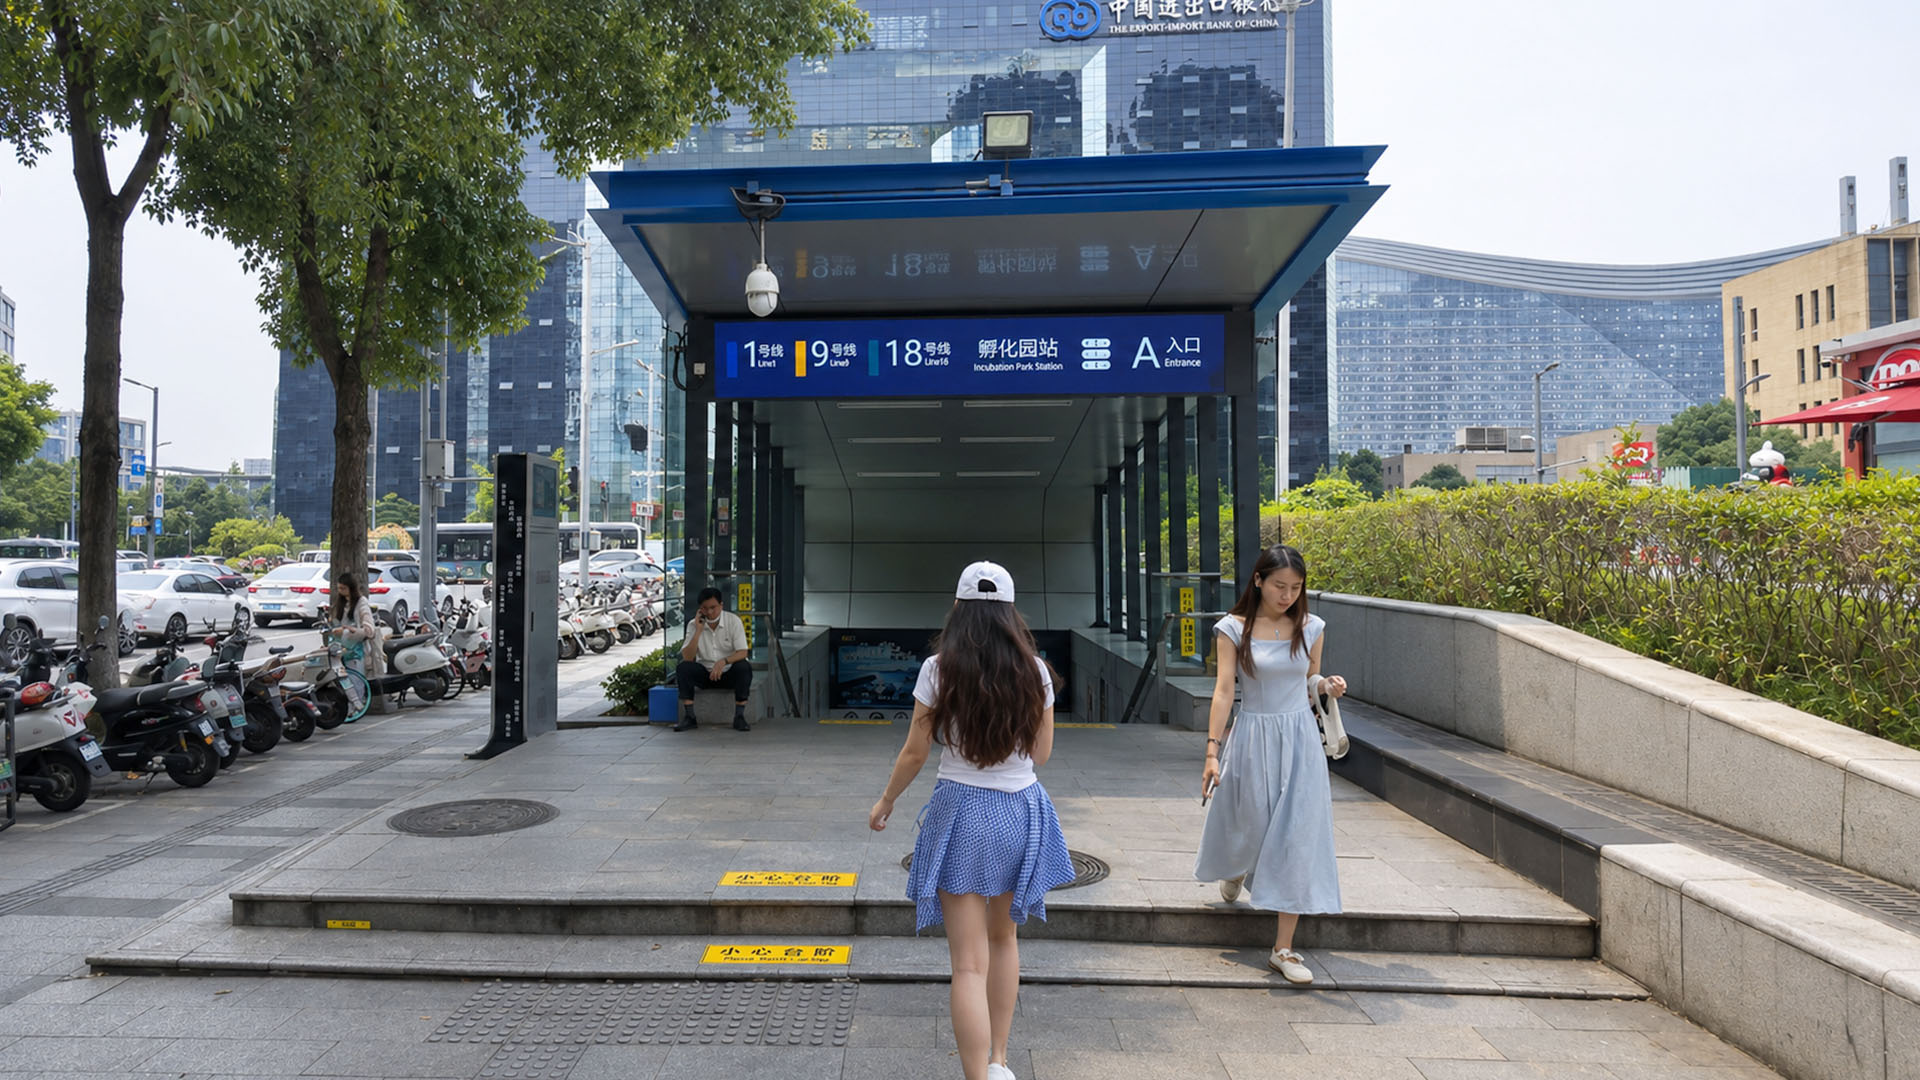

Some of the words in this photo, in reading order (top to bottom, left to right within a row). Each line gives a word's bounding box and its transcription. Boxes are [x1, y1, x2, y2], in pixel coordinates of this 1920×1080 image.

[1109, 25, 1128, 33] THE
[1207, 21, 1232, 30] BANK
[1235, 20, 1246, 28] OF
[1250, 19, 1279, 27] CHINA
[978, 337, 1059, 358] 孵化园站
[1132, 336, 1161, 369] A
[1166, 336, 1201, 353] 入口
[973, 363, 1015, 372] Incubation
[1015, 363, 1034, 371] Park
[1035, 362, 1063, 371] Station
[1164, 358, 1202, 368] Entrance
